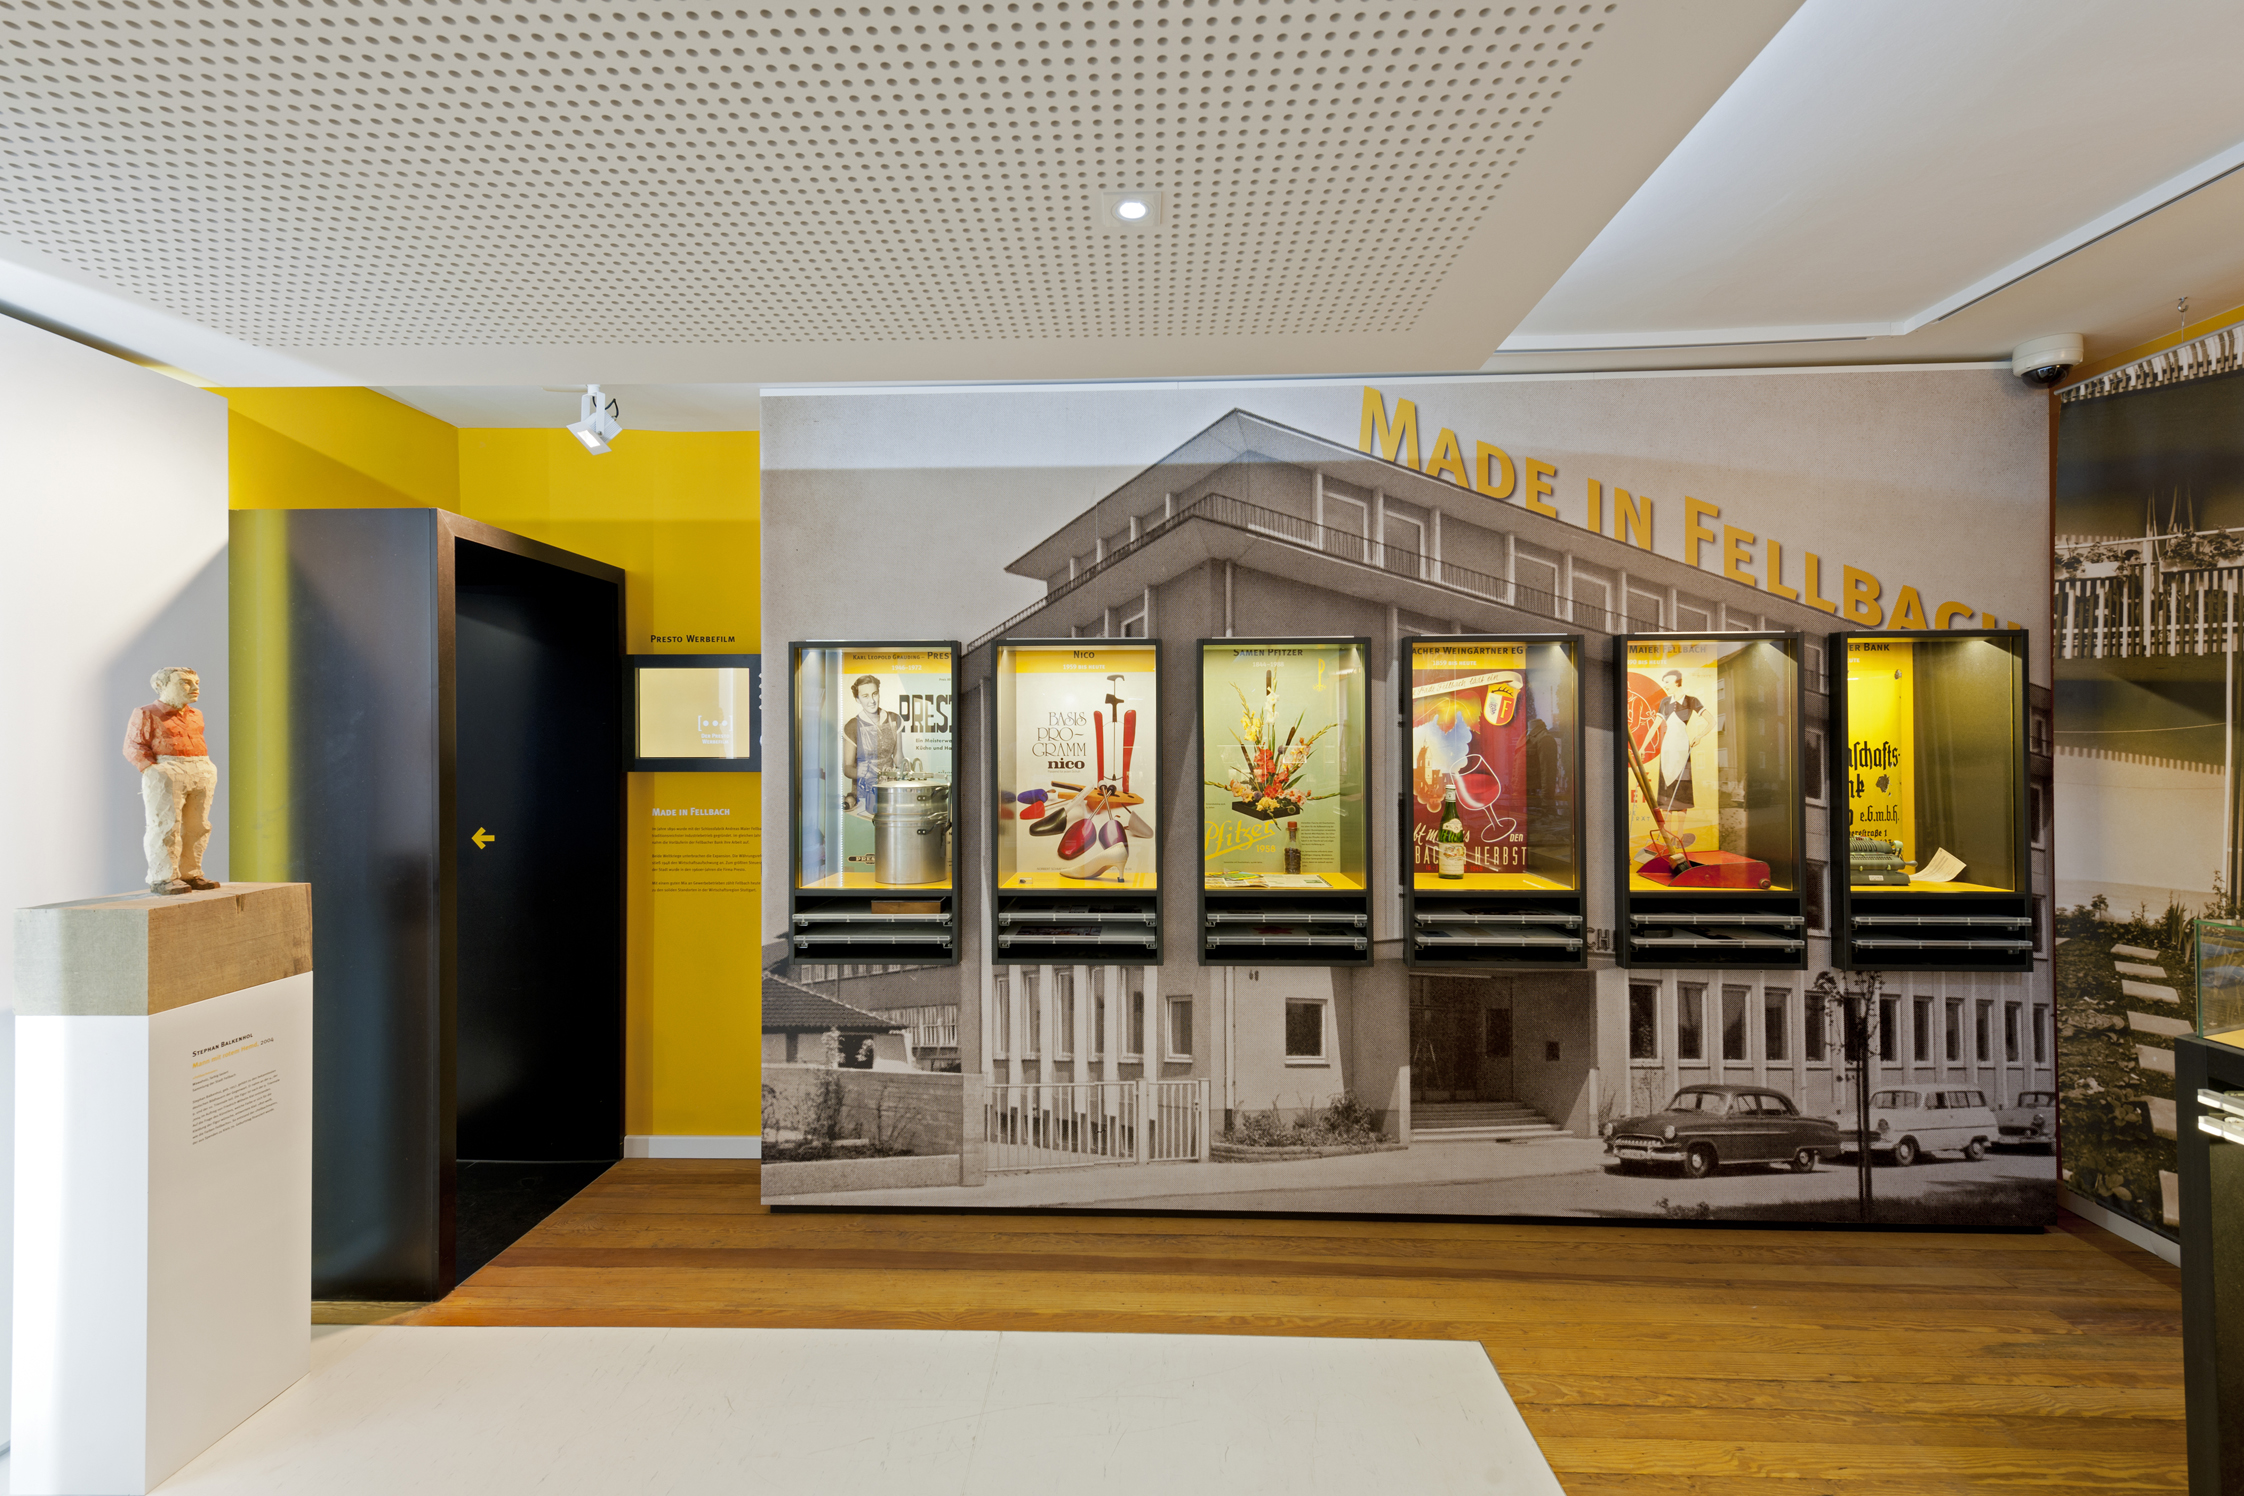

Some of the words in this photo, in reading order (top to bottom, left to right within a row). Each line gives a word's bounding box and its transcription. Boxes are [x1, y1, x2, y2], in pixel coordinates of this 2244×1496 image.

[1359, 386, 1557, 519] MADE
[1587, 477, 1652, 552] IN
[1684, 495, 2021, 630] FELLBAC
[650, 634, 683, 642] PRESTO
[686, 634, 736, 642] WERBEFILM
[1442, 646, 1508, 654] WEINGÄRTNER
[1629, 645, 1659, 654] MAIER
[1864, 643, 1890, 651] BANK
[927, 652, 952, 660] PRES
[1049, 712, 1087, 726] BASIS
[1032, 742, 1086, 758] GRAMM
[1048, 758, 1085, 770] nico
[652, 808, 677, 816] MADE
[690, 807, 730, 816] FELLBACH
[1475, 846, 1527, 865] HERBST
[192, 1044, 219, 1057] STEPHAN
[220, 1033, 253, 1047] BALKENHOL
